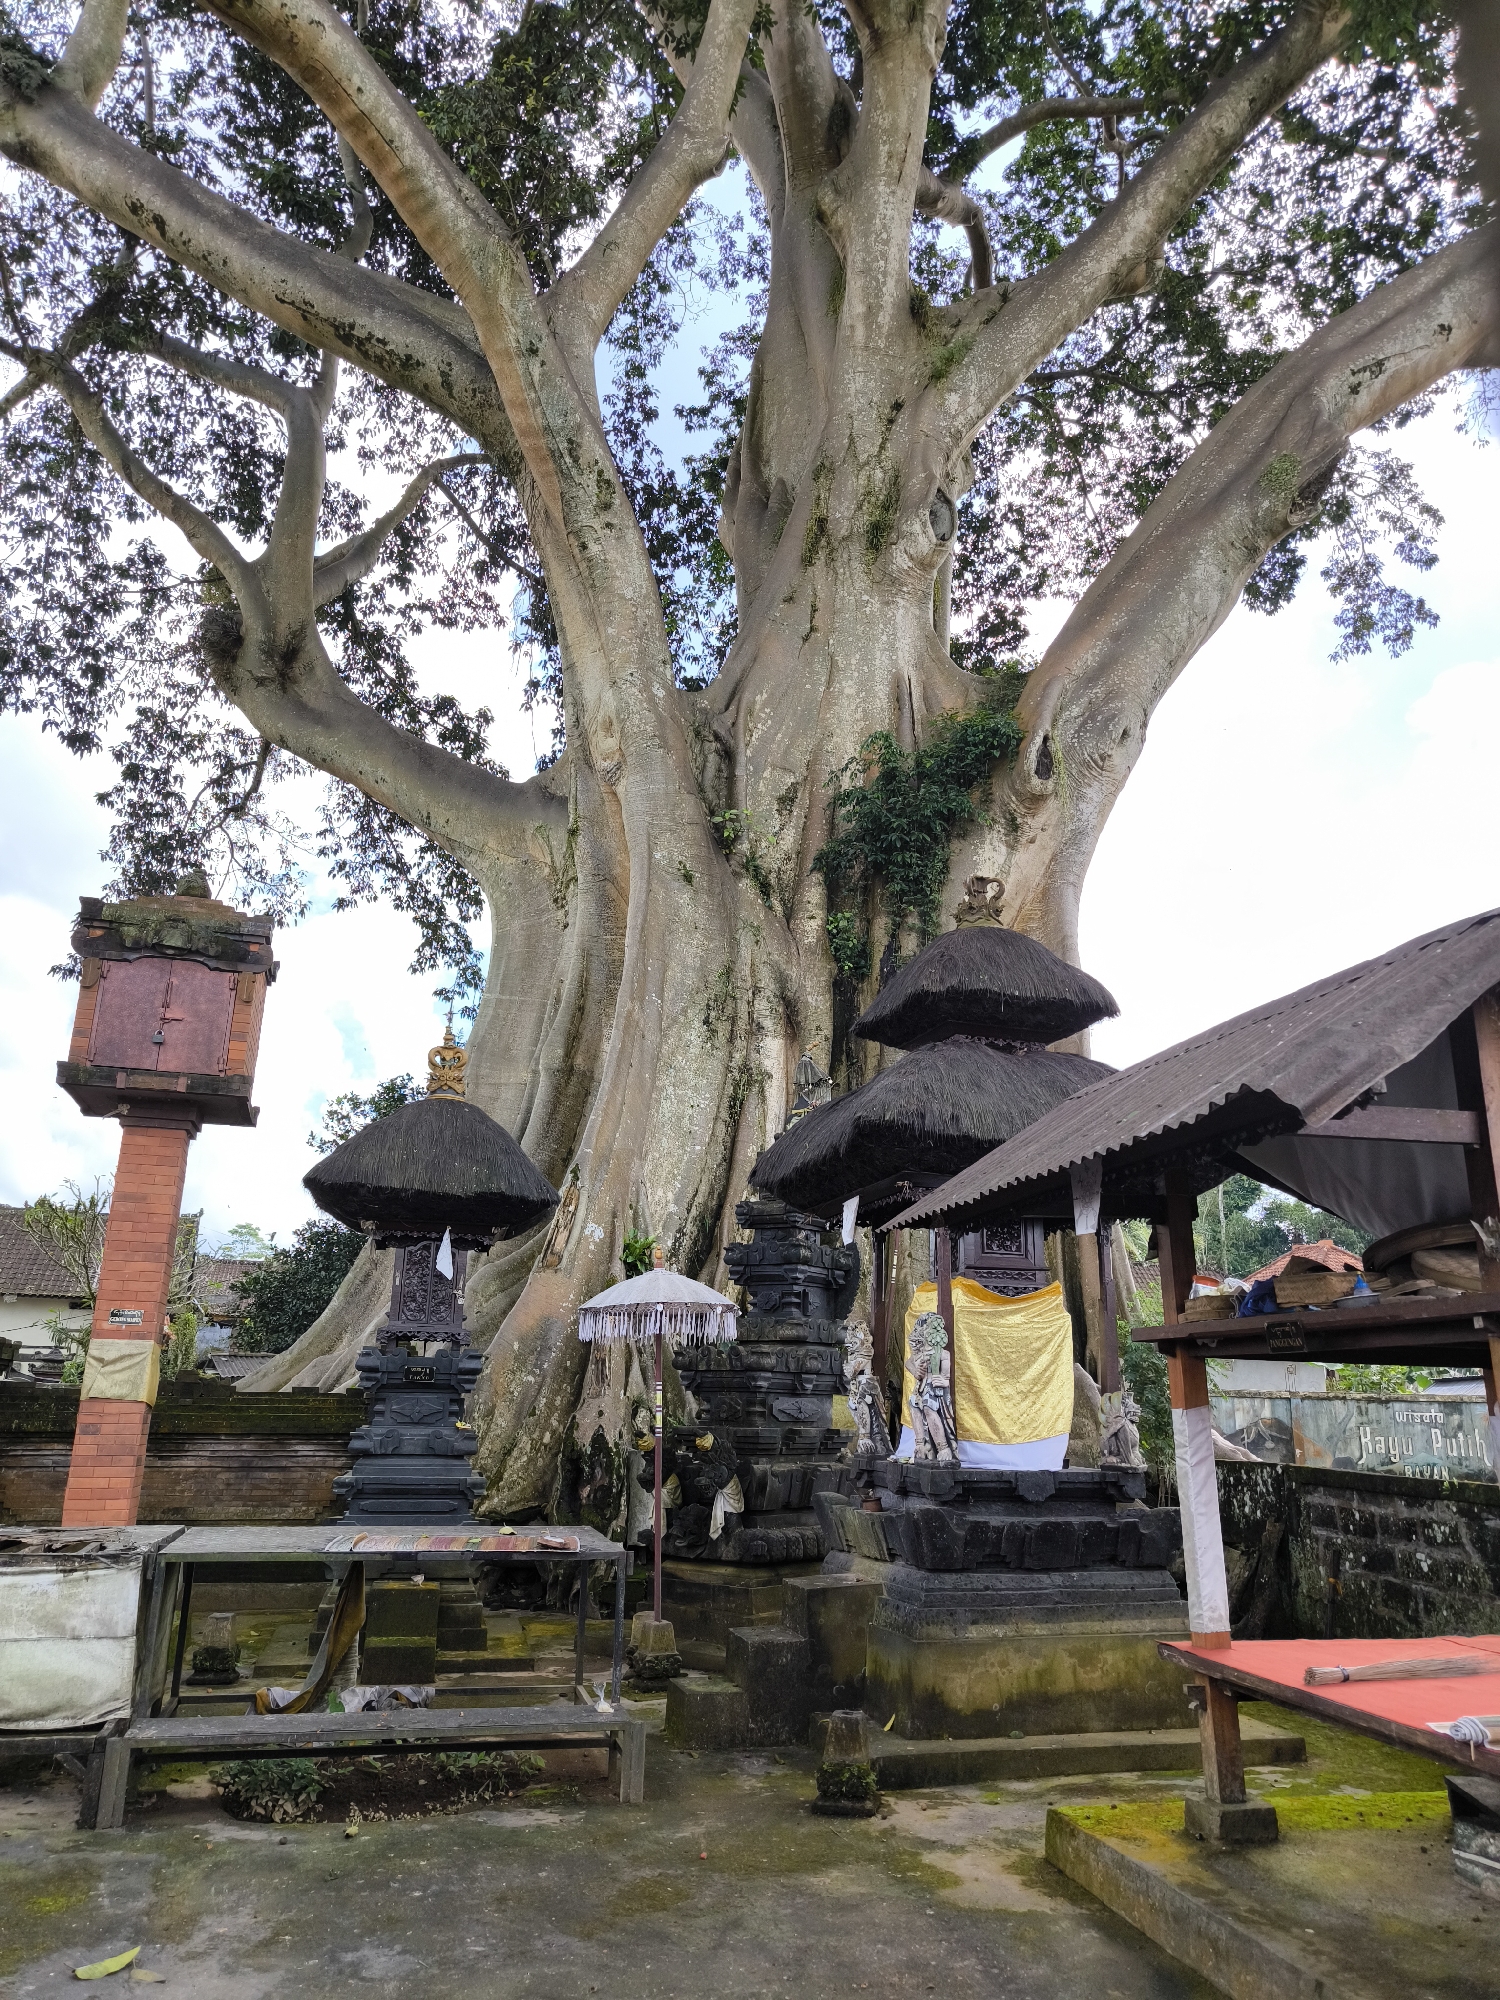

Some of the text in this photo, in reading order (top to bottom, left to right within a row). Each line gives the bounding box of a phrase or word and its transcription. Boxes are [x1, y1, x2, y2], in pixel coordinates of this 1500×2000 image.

[1357, 1426, 1493, 1467] Kayu Putih
[1404, 1465, 1450, 1480] BAYAN
